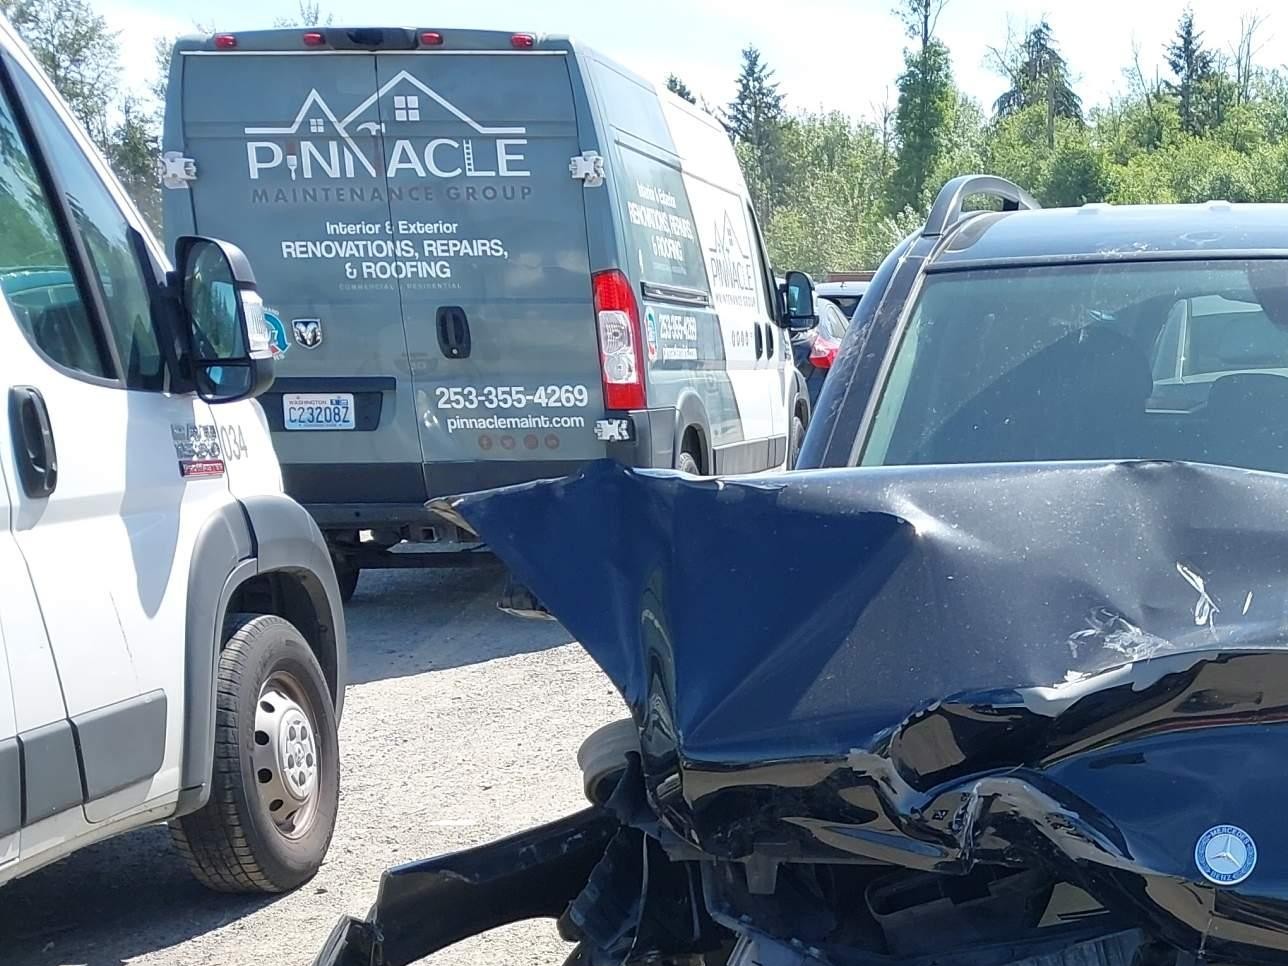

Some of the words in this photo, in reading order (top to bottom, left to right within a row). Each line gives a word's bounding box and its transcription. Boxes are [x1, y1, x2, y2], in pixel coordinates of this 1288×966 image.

[247, 138, 531, 180] PINNACLE
[251, 186, 434, 203] MAINTENANCE
[446, 186, 532, 201] GROUP
[326, 221, 381, 235] Interior
[385, 221, 393, 234] &
[398, 220, 458, 234] Exterior
[281, 240, 419, 259] RENOVATIONS,
[423, 239, 508, 258] REPAIRS,
[345, 263, 357, 279] &
[362, 261, 451, 279] ROOFING
[435, 385, 588, 409] 253-355-4269
[289, 406, 350, 423] C23208Z
[447, 415, 584, 432] pinnaclemaint.com
[220, 424, 248, 461] 034
